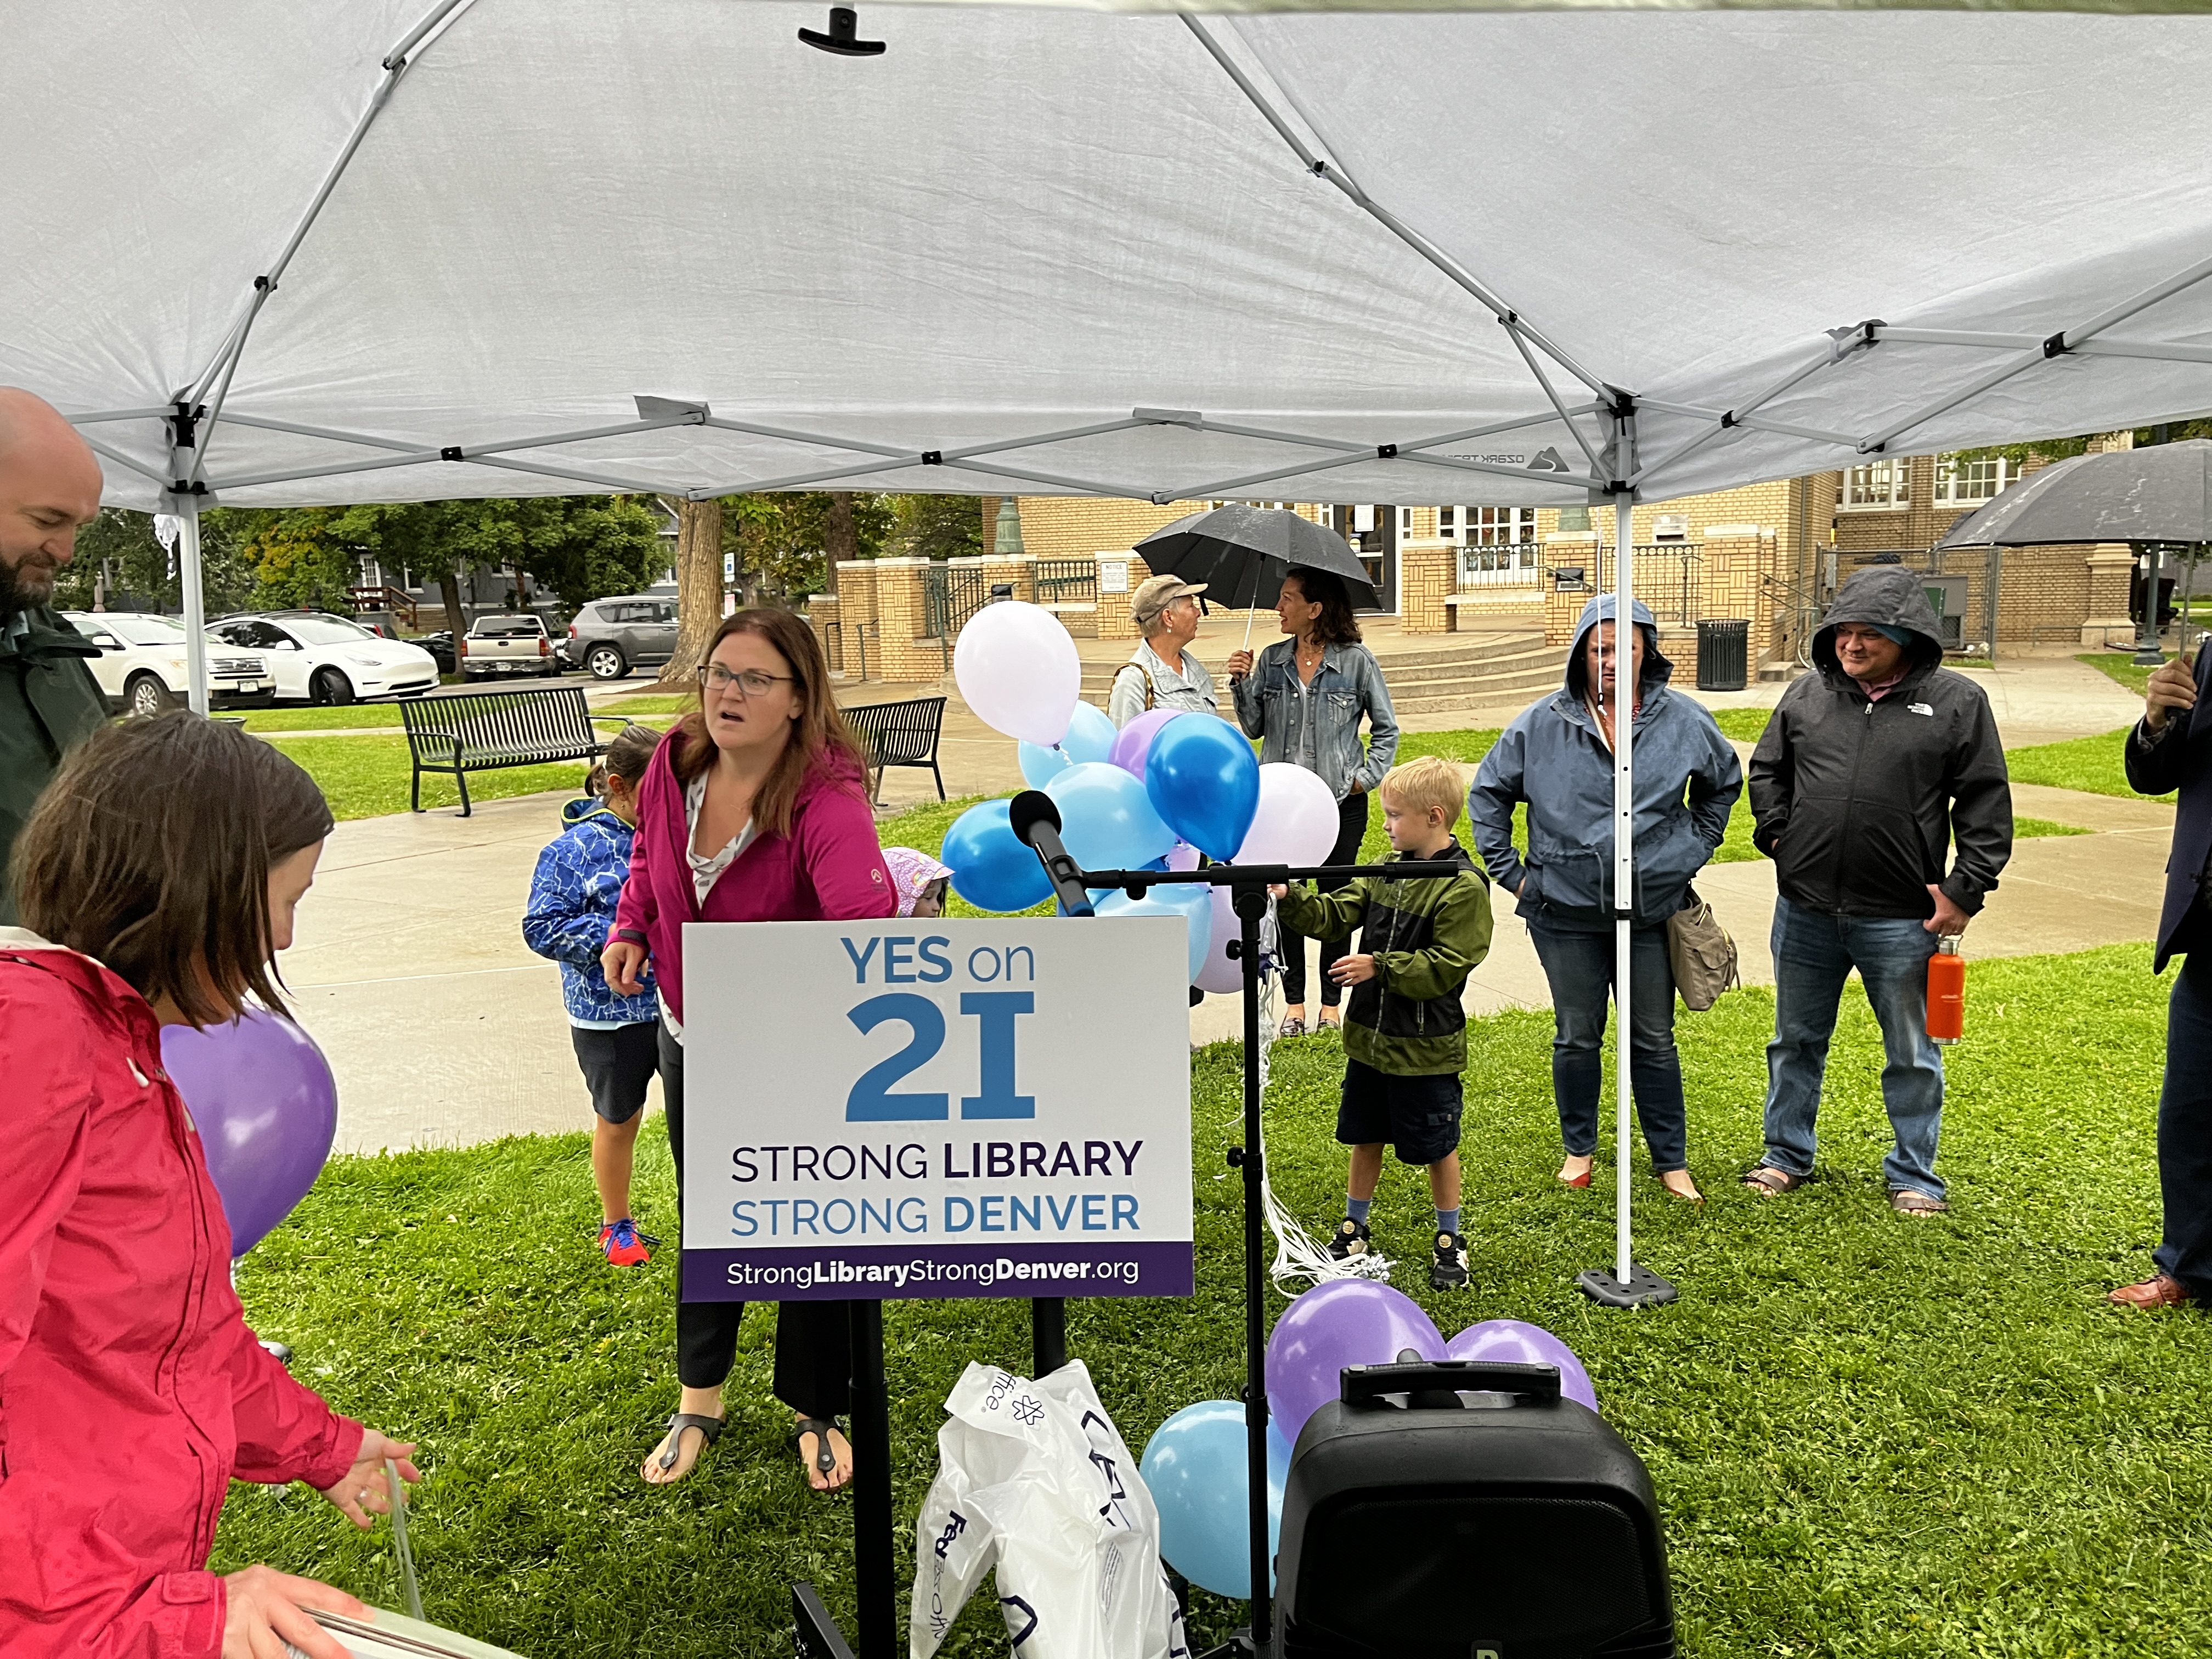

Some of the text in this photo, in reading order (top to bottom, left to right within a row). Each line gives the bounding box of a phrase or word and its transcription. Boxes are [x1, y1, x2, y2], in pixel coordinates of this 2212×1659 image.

[840, 936, 1035, 984] YES on
[845, 991, 1035, 1122] 2I
[731, 1141, 1143, 1182] STRONG LIBRARY
[731, 1194, 1140, 1237] STRONG DENVER
[727, 1258, 1139, 1289] StrongLibraryStrongDenver.org
[986, 1372, 1016, 1410] ffice
[930, 1593, 950, 1641] Offic
